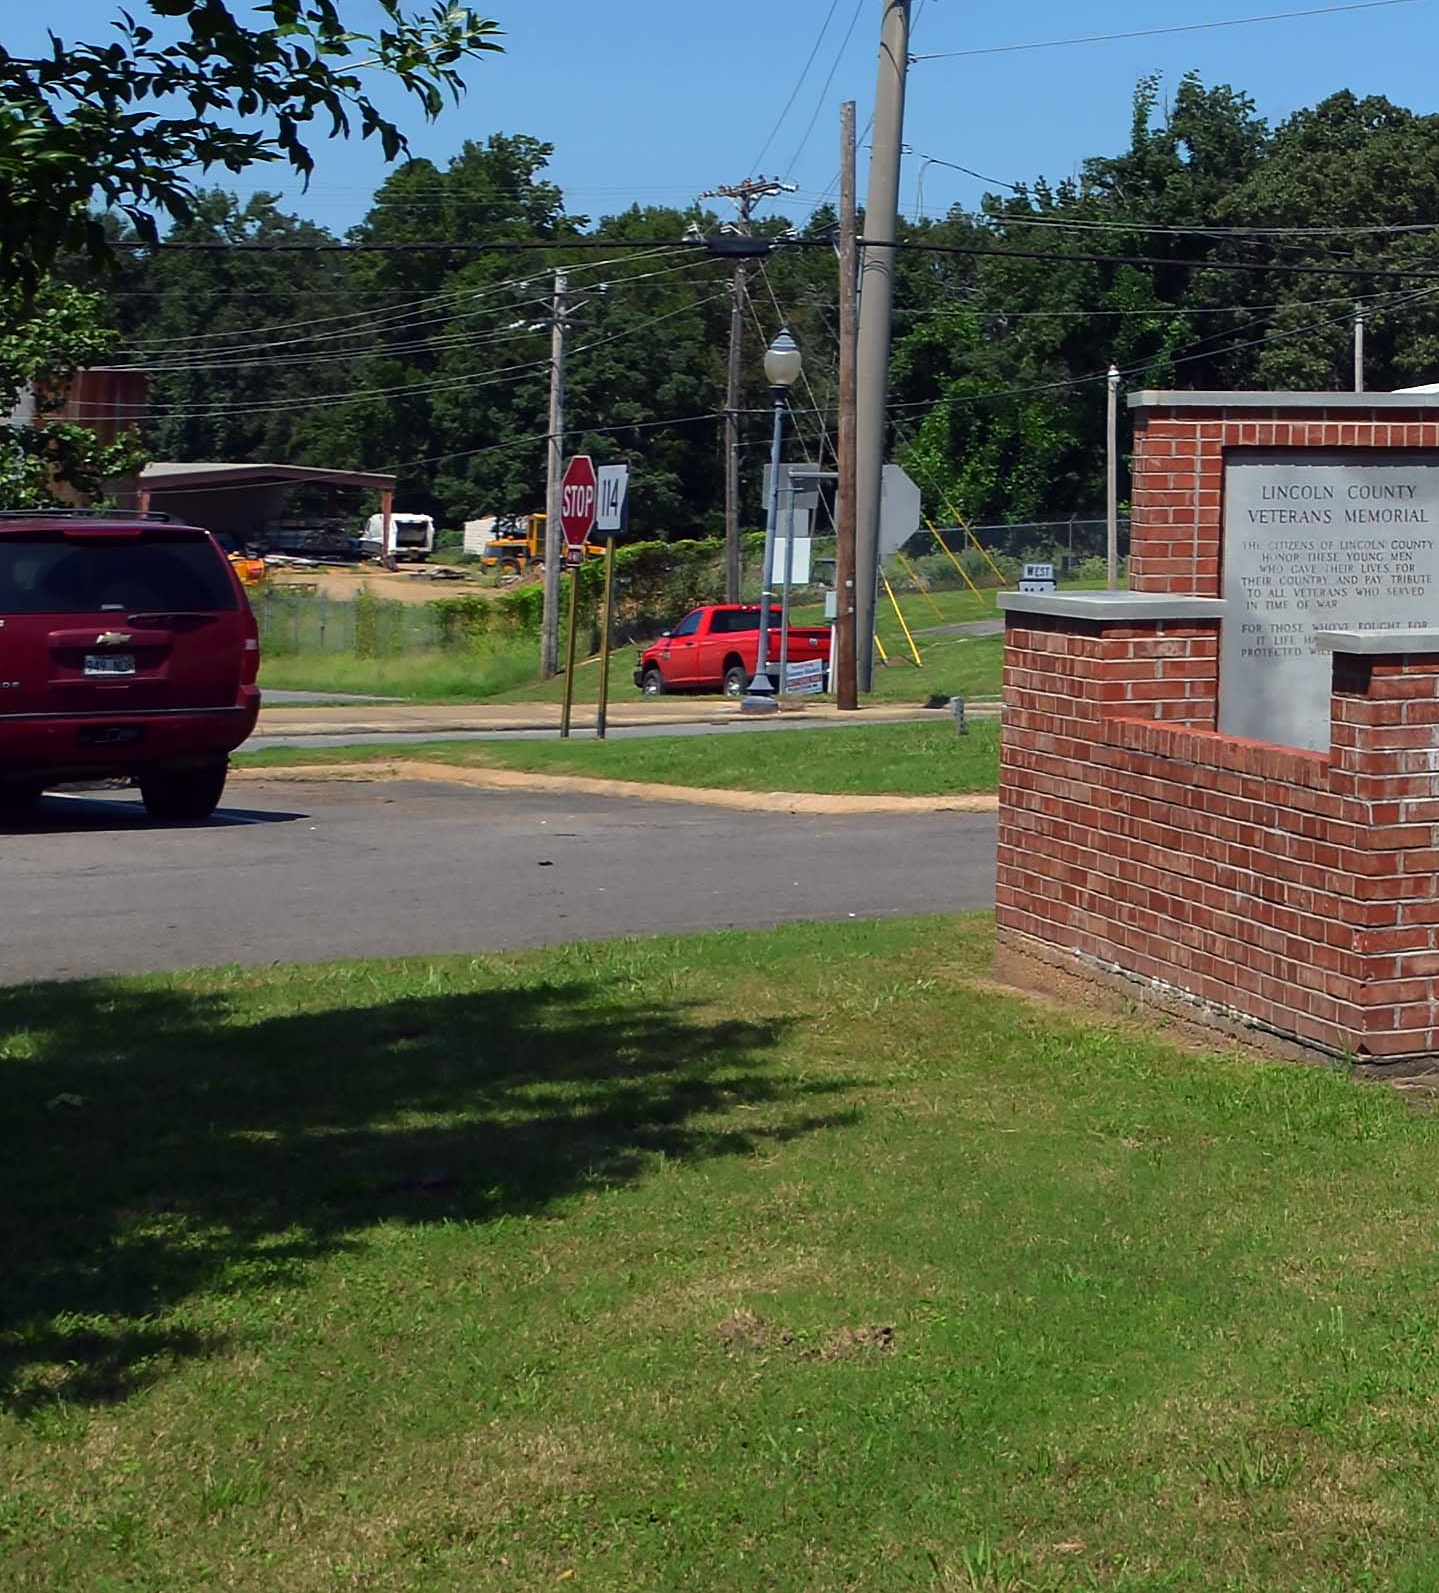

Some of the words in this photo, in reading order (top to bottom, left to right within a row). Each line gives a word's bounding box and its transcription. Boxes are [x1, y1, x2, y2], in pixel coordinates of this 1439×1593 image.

[1263, 485, 1333, 499] LINCOLN
[1348, 485, 1416, 499] COUNTY
[563, 486, 593, 517] STOP
[602, 479, 619, 517] 114
[1248, 509, 1332, 523] VETERANS
[1345, 509, 1429, 523] MEMORIAL
[1321, 541, 1333, 550] OF
[1340, 541, 1385, 550] LINCOLN
[1391, 541, 1433, 550] COUNTY
[1263, 553, 1299, 562] HONOR
[1308, 553, 1338, 562] THESE
[1347, 553, 1383, 562] YOUNG
[1391, 553, 1412, 562] MEN
[1027, 567, 1049, 576] WEST
[1260, 565, 1283, 573] WHO
[1291, 565, 1315, 573] GAVE
[1325, 565, 1353, 573] THEIR
[1361, 565, 1389, 573] LIVES
[1396, 565, 1415, 573] FOR
[1242, 575, 1271, 585] THEIR
[1280, 575, 1327, 585] COUNTRY
[1337, 575, 1357, 585] AND
[1365, 575, 1382, 585] PAY
[1391, 575, 1432, 585] TRIBUTE
[1248, 588, 1261, 597] TO
[1269, 588, 1285, 597] ALL
[1294, 588, 1348, 597] VETERANS
[1356, 588, 1379, 597] WHO
[1387, 588, 1424, 597] SERVED
[1247, 600, 1257, 609] IN
[1266, 600, 1288, 609] TIME
[1297, 600, 1309, 609] OF
[1317, 600, 1338, 609] WAR
[1242, 624, 1262, 633] FOR
[1271, 624, 1303, 632] THOSE
[1257, 636, 1265, 645] IT
[1275, 636, 1294, 645] LIFE
[1304, 635, 1317, 644] HA
[1242, 648, 1300, 657] PROTECTED
